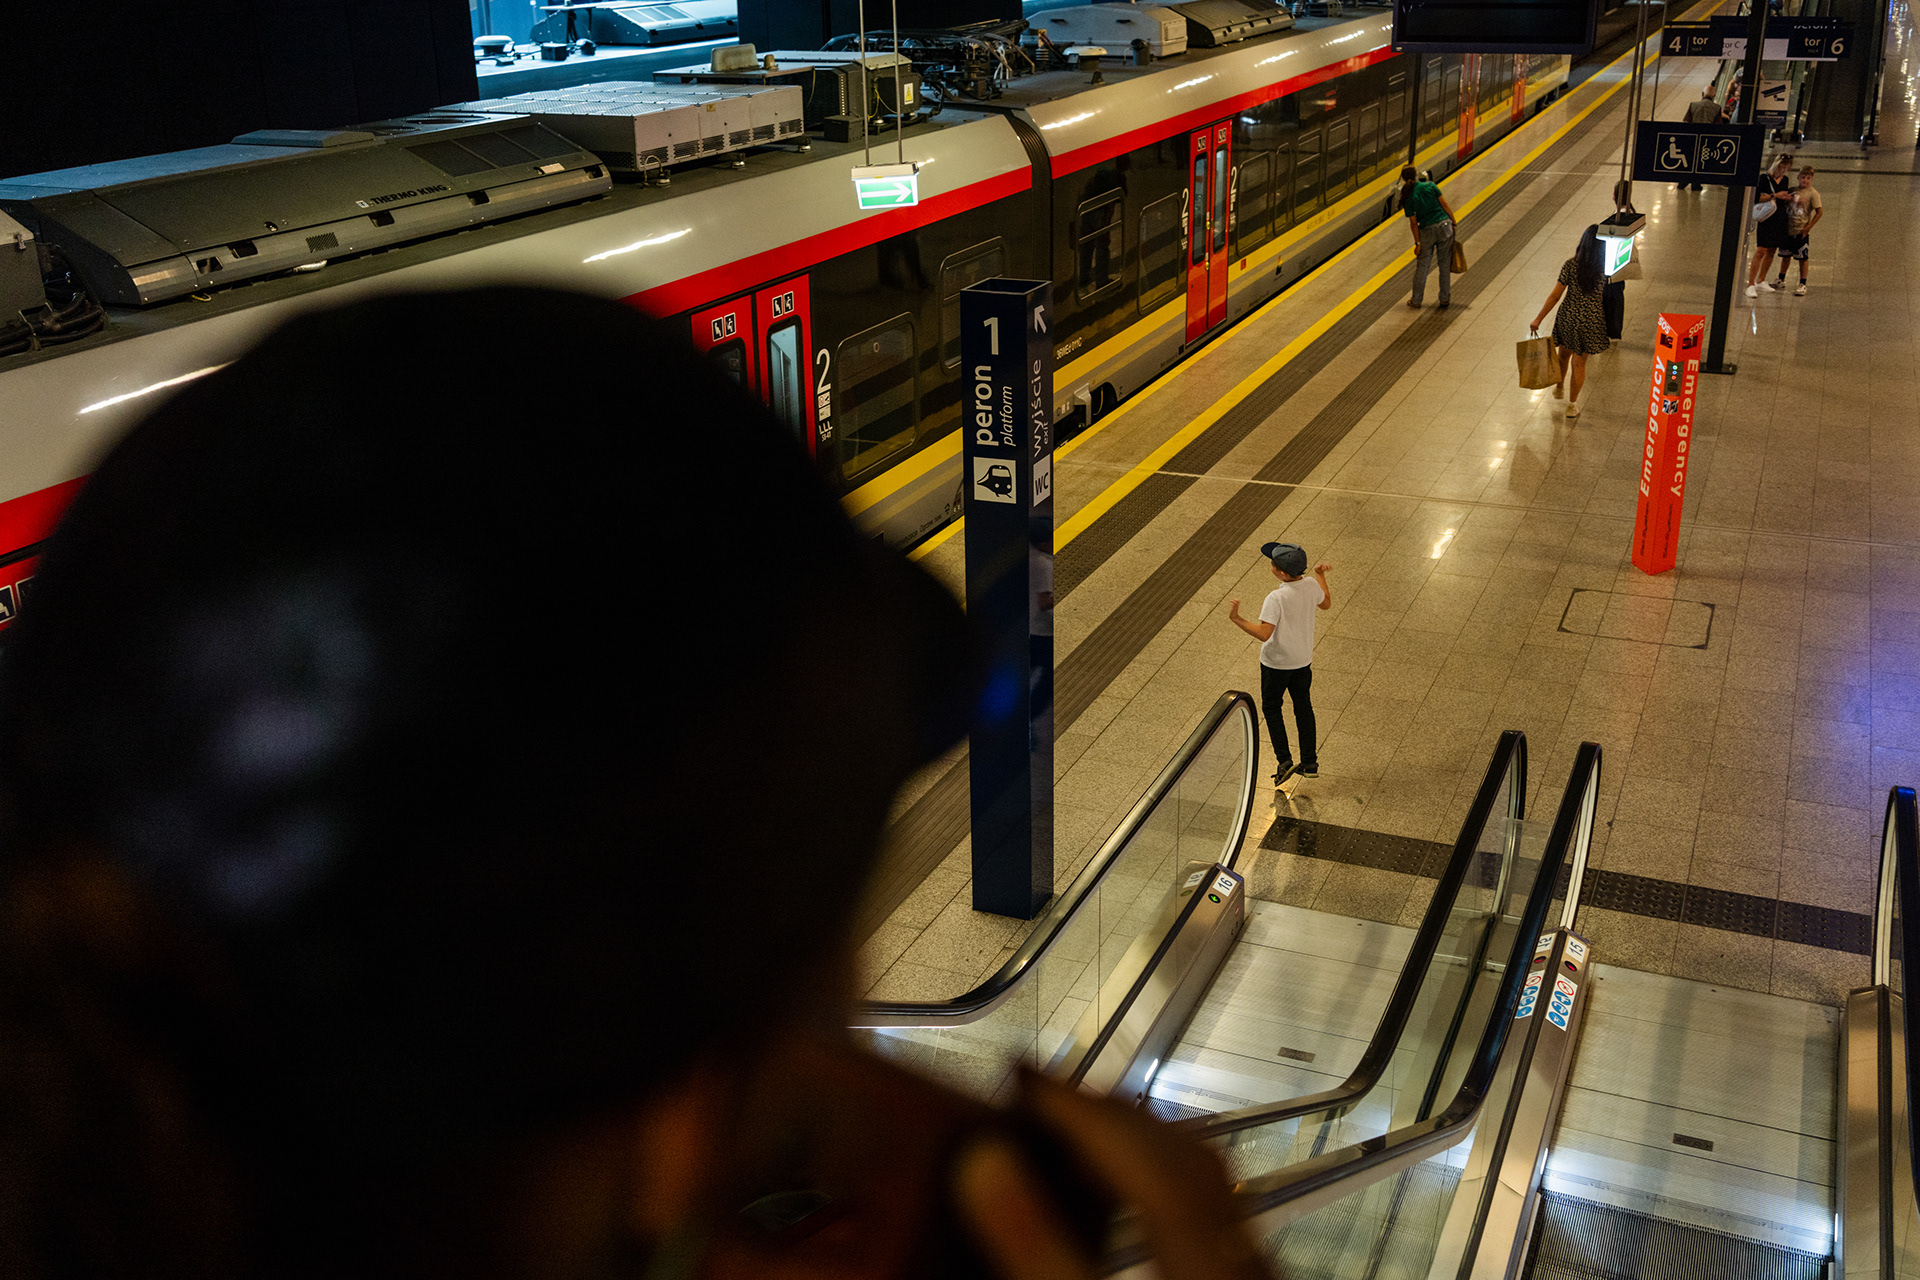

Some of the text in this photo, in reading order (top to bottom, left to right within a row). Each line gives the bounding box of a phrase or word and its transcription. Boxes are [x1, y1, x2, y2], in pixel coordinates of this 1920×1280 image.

[1668, 35, 1682, 53] 4
[1692, 36, 1709, 46] tor
[1804, 36, 1845, 55] tor 6
[1230, 165, 1238, 194] 2
[370, 185, 448, 205] THERMO KING
[1181, 187, 1190, 218] 2
[1657, 316, 1671, 335] SOS
[1688, 319, 1705, 337] SOS
[816, 348, 832, 395] 2
[974, 316, 1001, 447] peron 1
[1000, 385, 1017, 448] platform
[1031, 358, 1043, 458] wyjście
[1042, 422, 1050, 446] exit
[1639, 355, 1666, 498] Emergency
[1670, 358, 1699, 498] Emergency
[1035, 472, 1049, 496] WC
[1217, 877, 1233, 891] 16
[1568, 941, 1583, 957] 15
